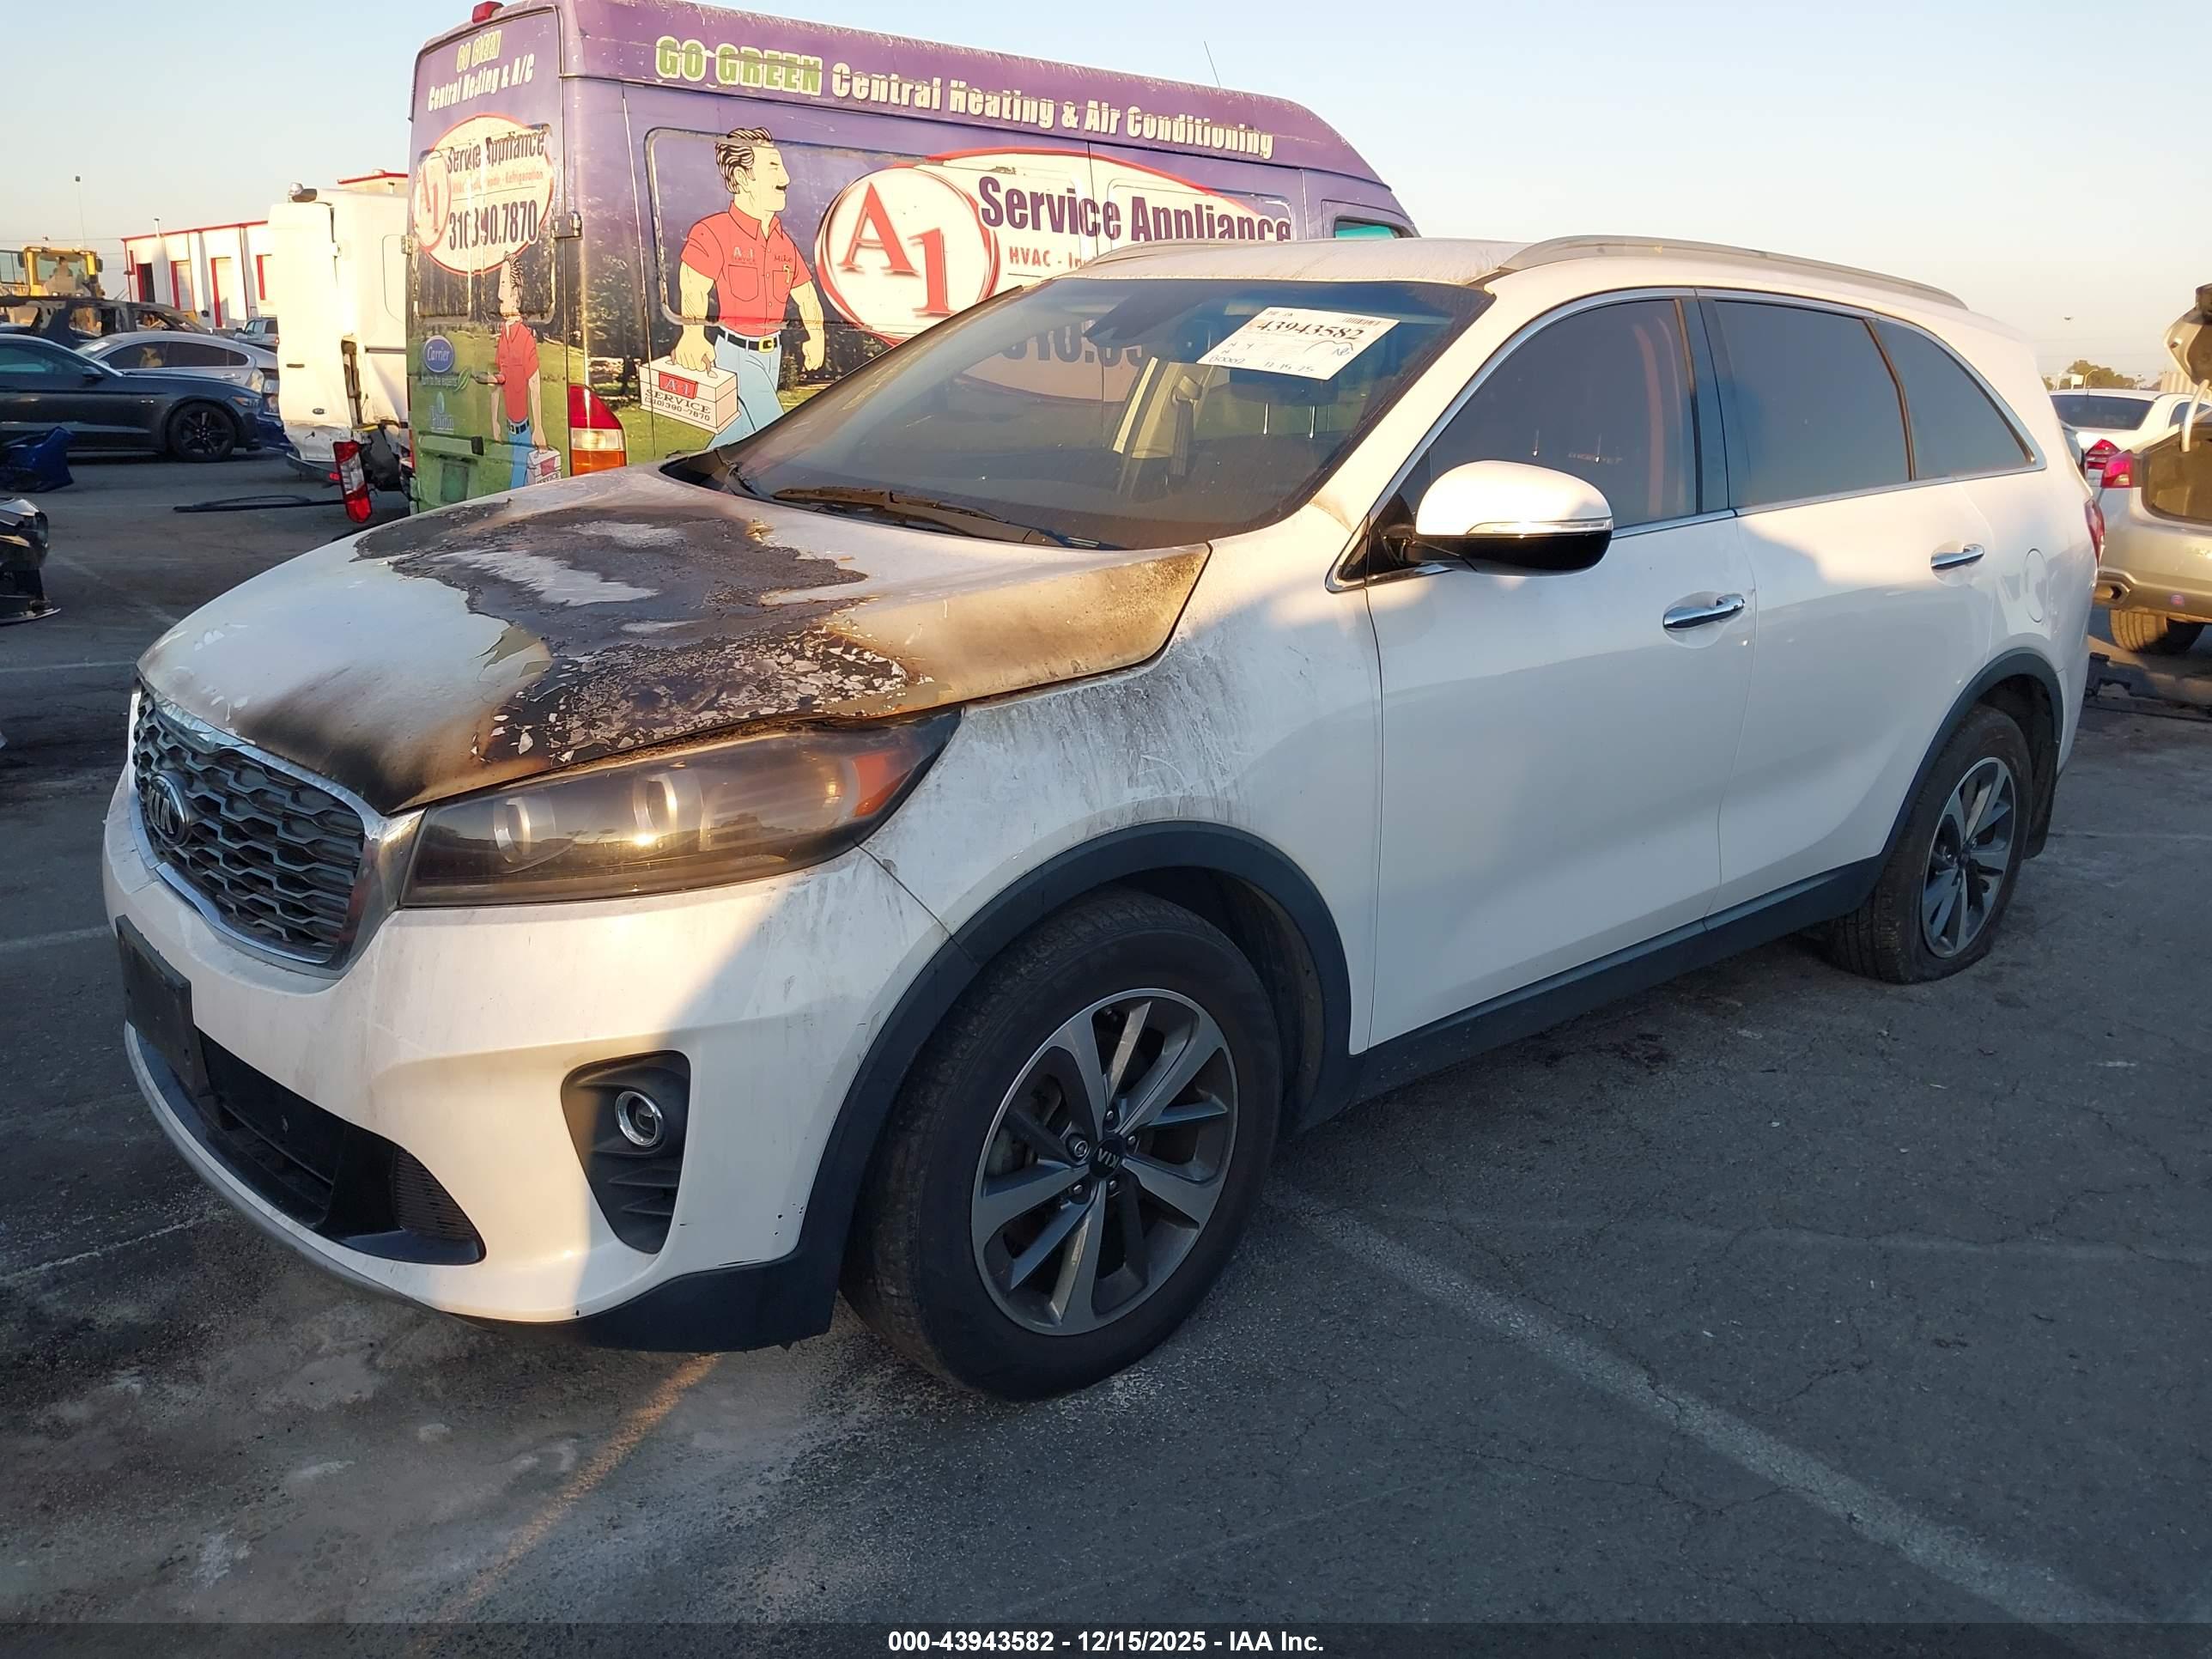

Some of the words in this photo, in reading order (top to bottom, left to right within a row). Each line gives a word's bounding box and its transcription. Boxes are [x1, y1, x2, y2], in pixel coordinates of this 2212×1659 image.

[457, 42, 471, 73] GO
[471, 29, 502, 68] GREEN
[428, 76, 463, 112] Central
[462, 67, 501, 101] Heating
[501, 64, 509, 88] &
[511, 53, 534, 86] A/C
[655, 35, 707, 82] GO
[715, 43, 823, 97] GREEN
[832, 62, 942, 111] Central
[949, 80, 1055, 129] Heating
[1061, 101, 1079, 129] &
[1085, 100, 1121, 135] Air
[1127, 106, 1273, 160] Conditioning
[978, 176, 1121, 240] Service
[836, 181, 959, 317] A1
[1009, 246, 1051, 267] HVAC
[1257, 319, 1365, 341] 43943582
[427, 346, 450, 362] Carrier
[645, 389, 712, 414] SERVICE
[1097, 1147, 1121, 1169] KIA
